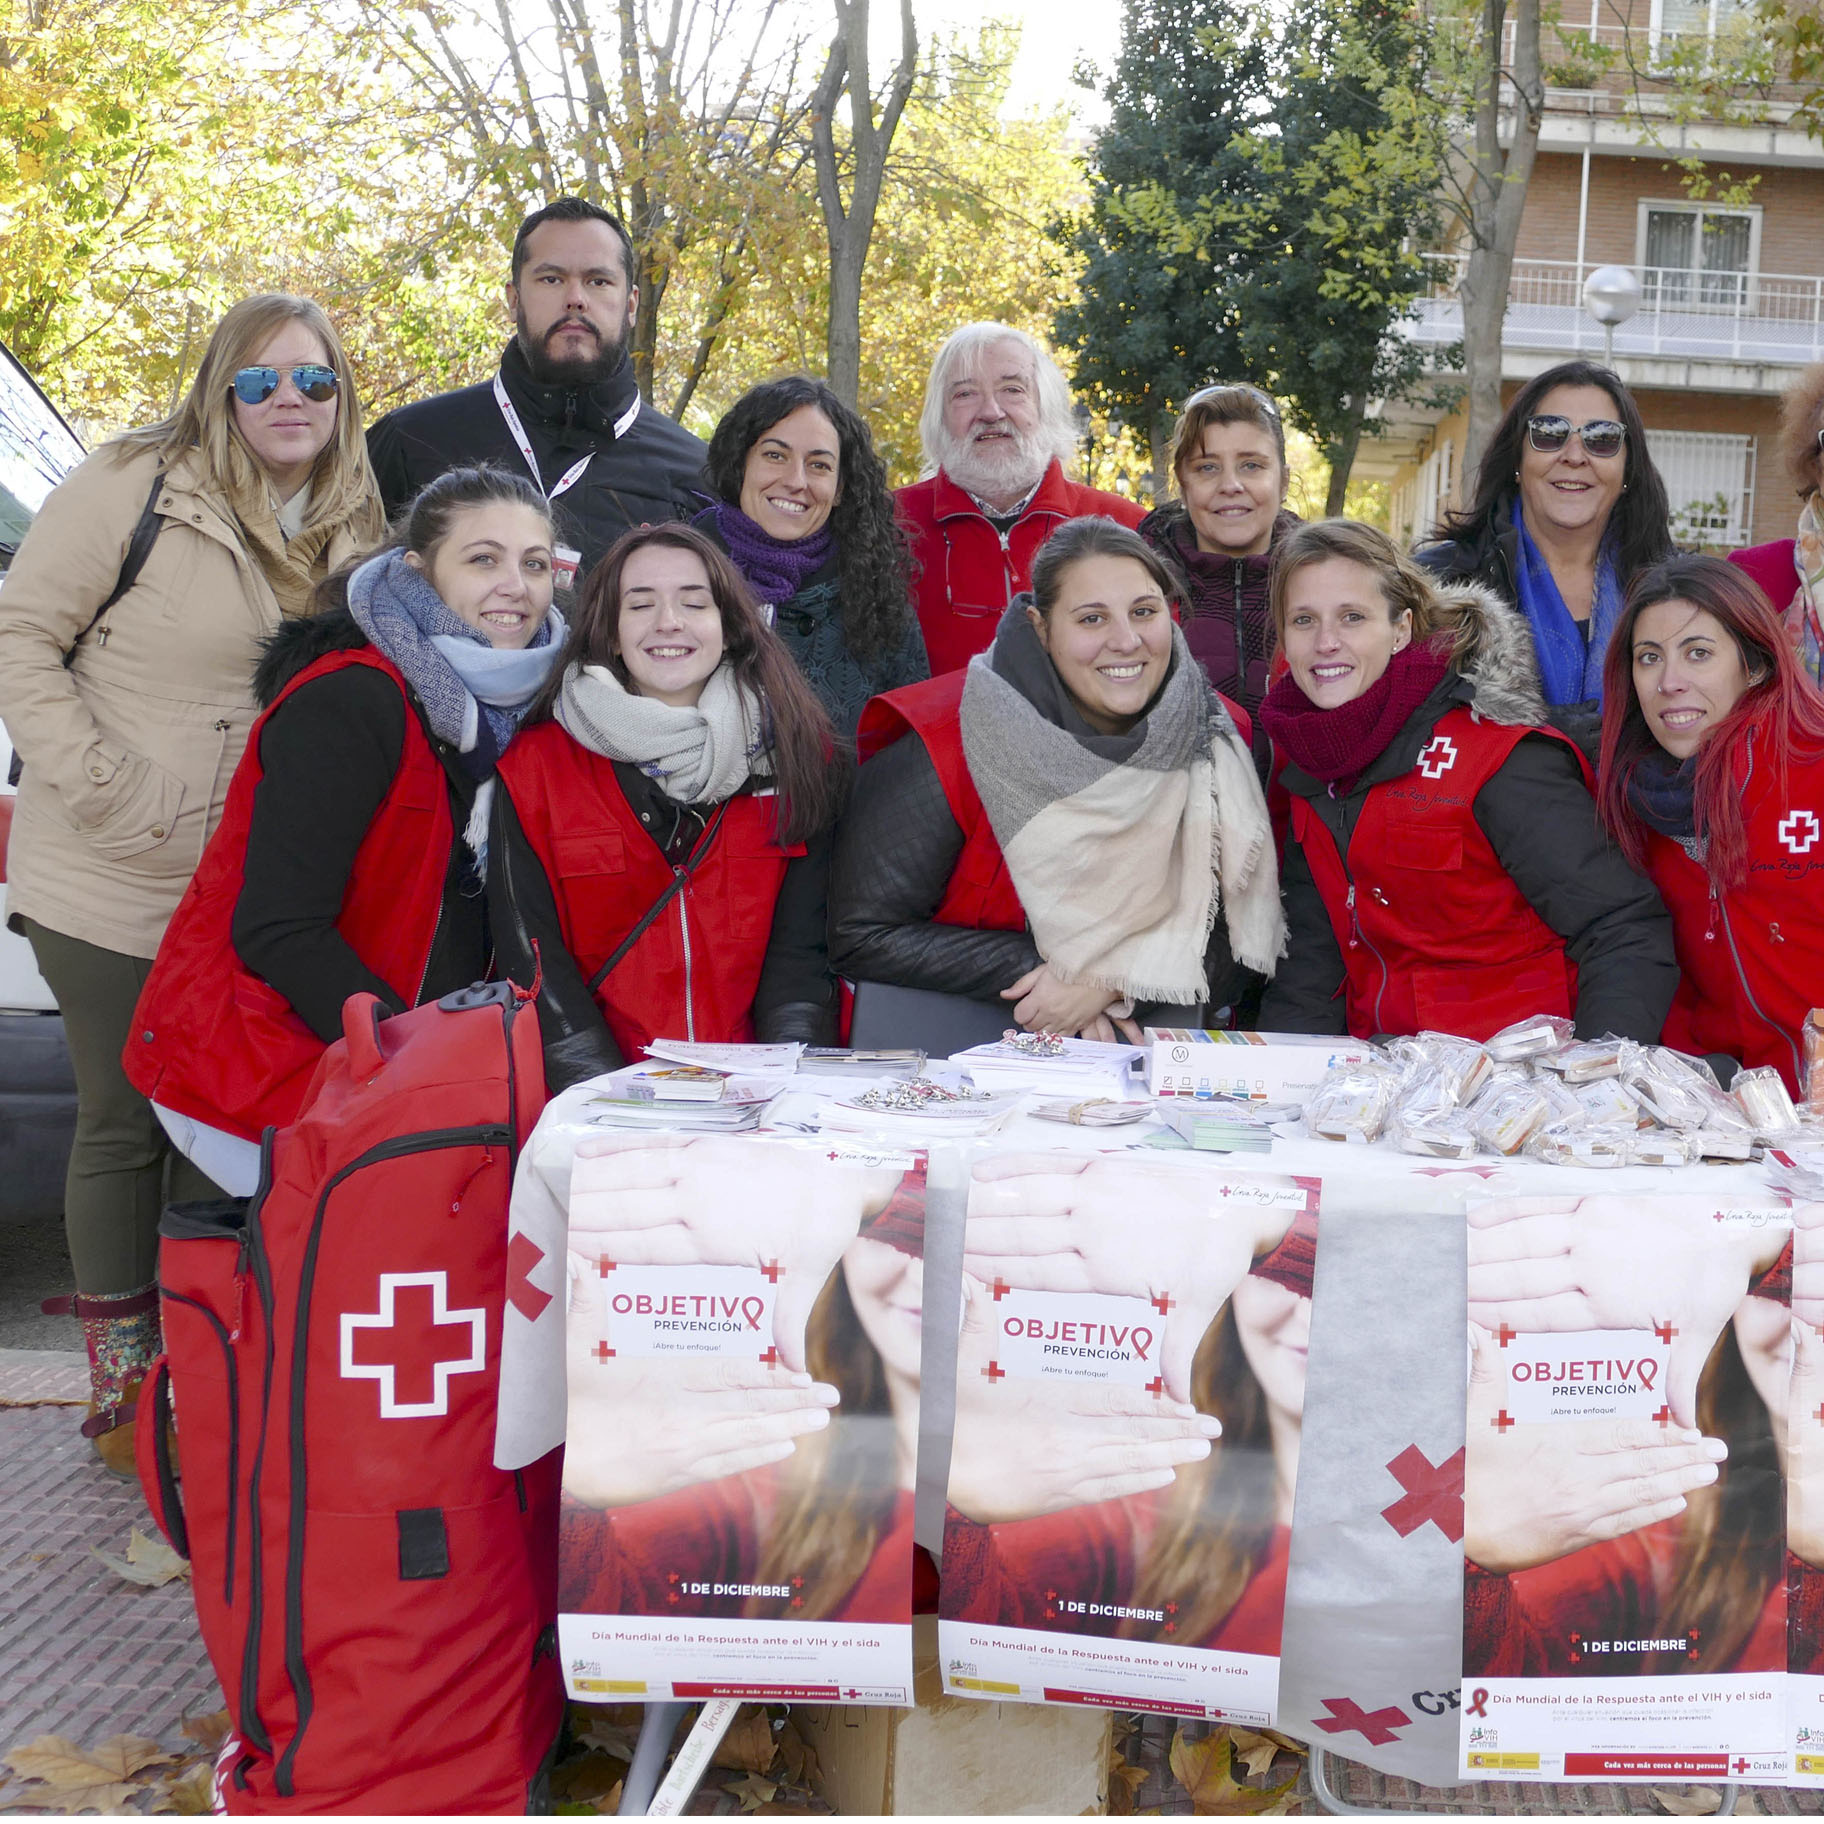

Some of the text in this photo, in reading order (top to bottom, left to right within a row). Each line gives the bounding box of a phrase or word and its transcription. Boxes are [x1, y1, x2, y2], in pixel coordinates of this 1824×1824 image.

[654, 1320, 742, 1332] PREVENCIÓN
[652, 1342, 674, 1350] ¡Abre
[686, 1343, 721, 1352] enfoque!
[681, 1583, 790, 1597] 1 DE DICIEMBRE
[592, 1631, 881, 1648] Día Mundial de la Respuesta ante el VIH y el sida
